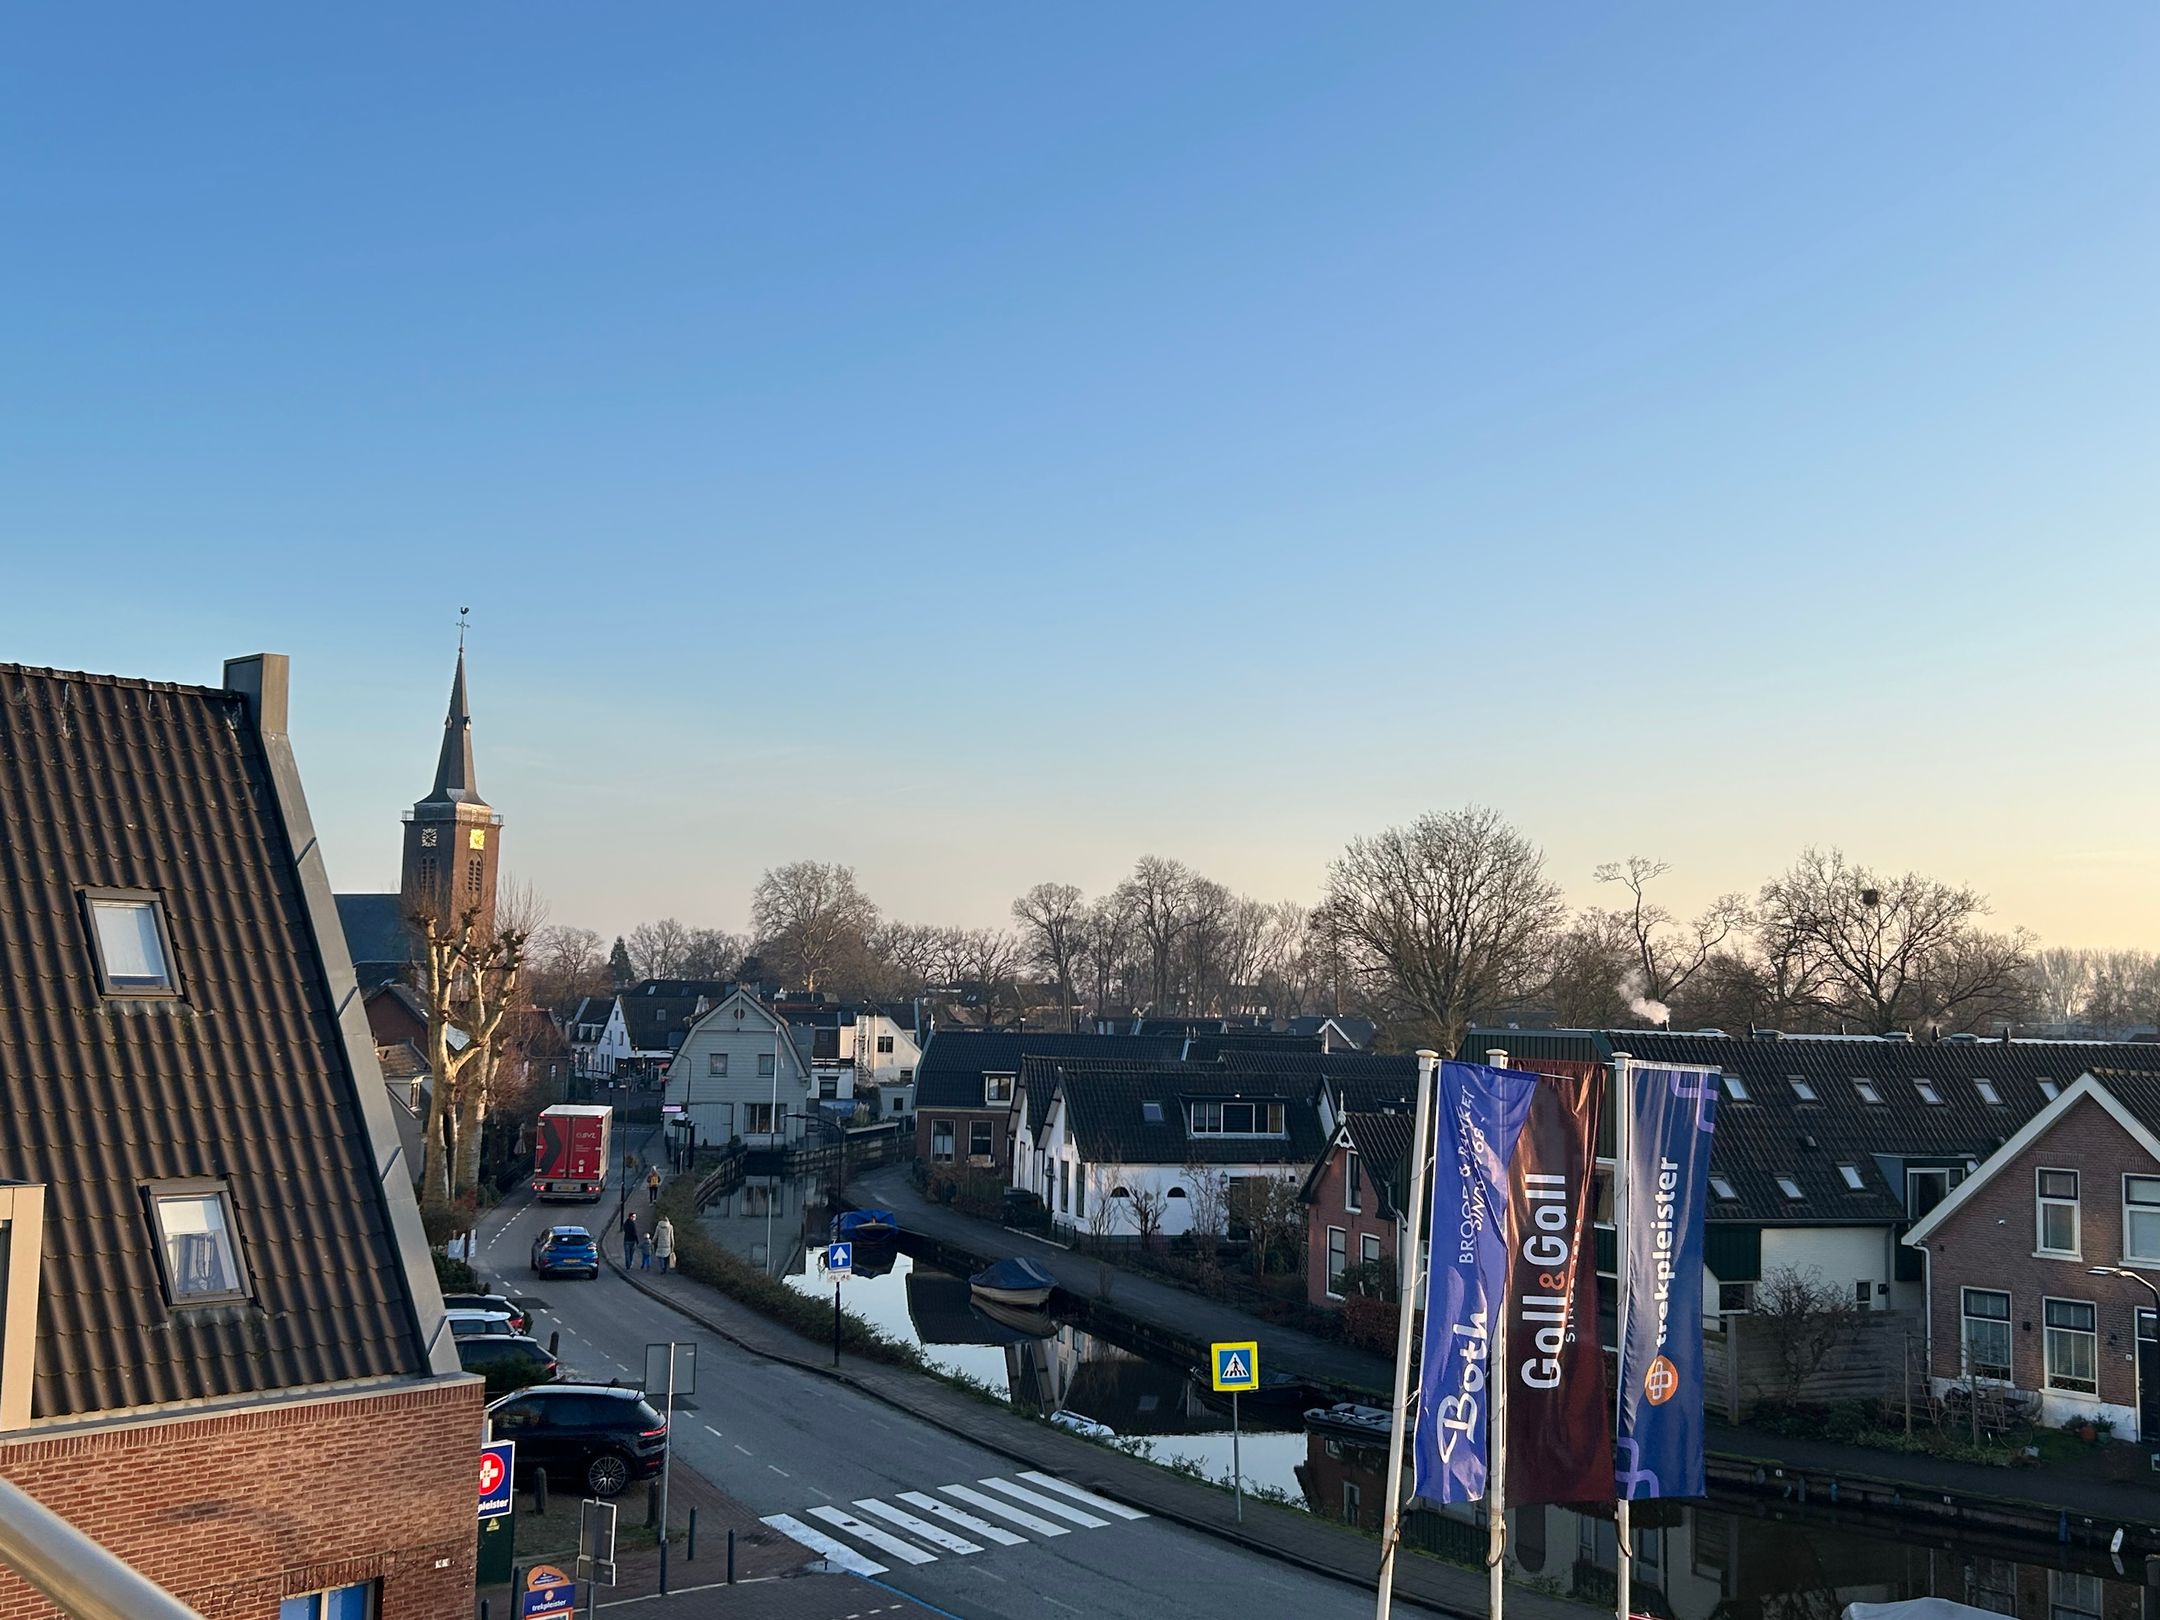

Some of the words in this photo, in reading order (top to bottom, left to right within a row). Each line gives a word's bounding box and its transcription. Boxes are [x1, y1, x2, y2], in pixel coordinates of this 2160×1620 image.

[1458, 1163, 1471, 1177] &
[1523, 1173, 1568, 1267] Gall
[1653, 1156, 1680, 1347] trekpleister
[1538, 1271, 1565, 1291] &
[1436, 1306, 1488, 1464] Both
[1521, 1295, 1565, 1390] Gall
[531, 1599, 567, 1612] trekpleister
